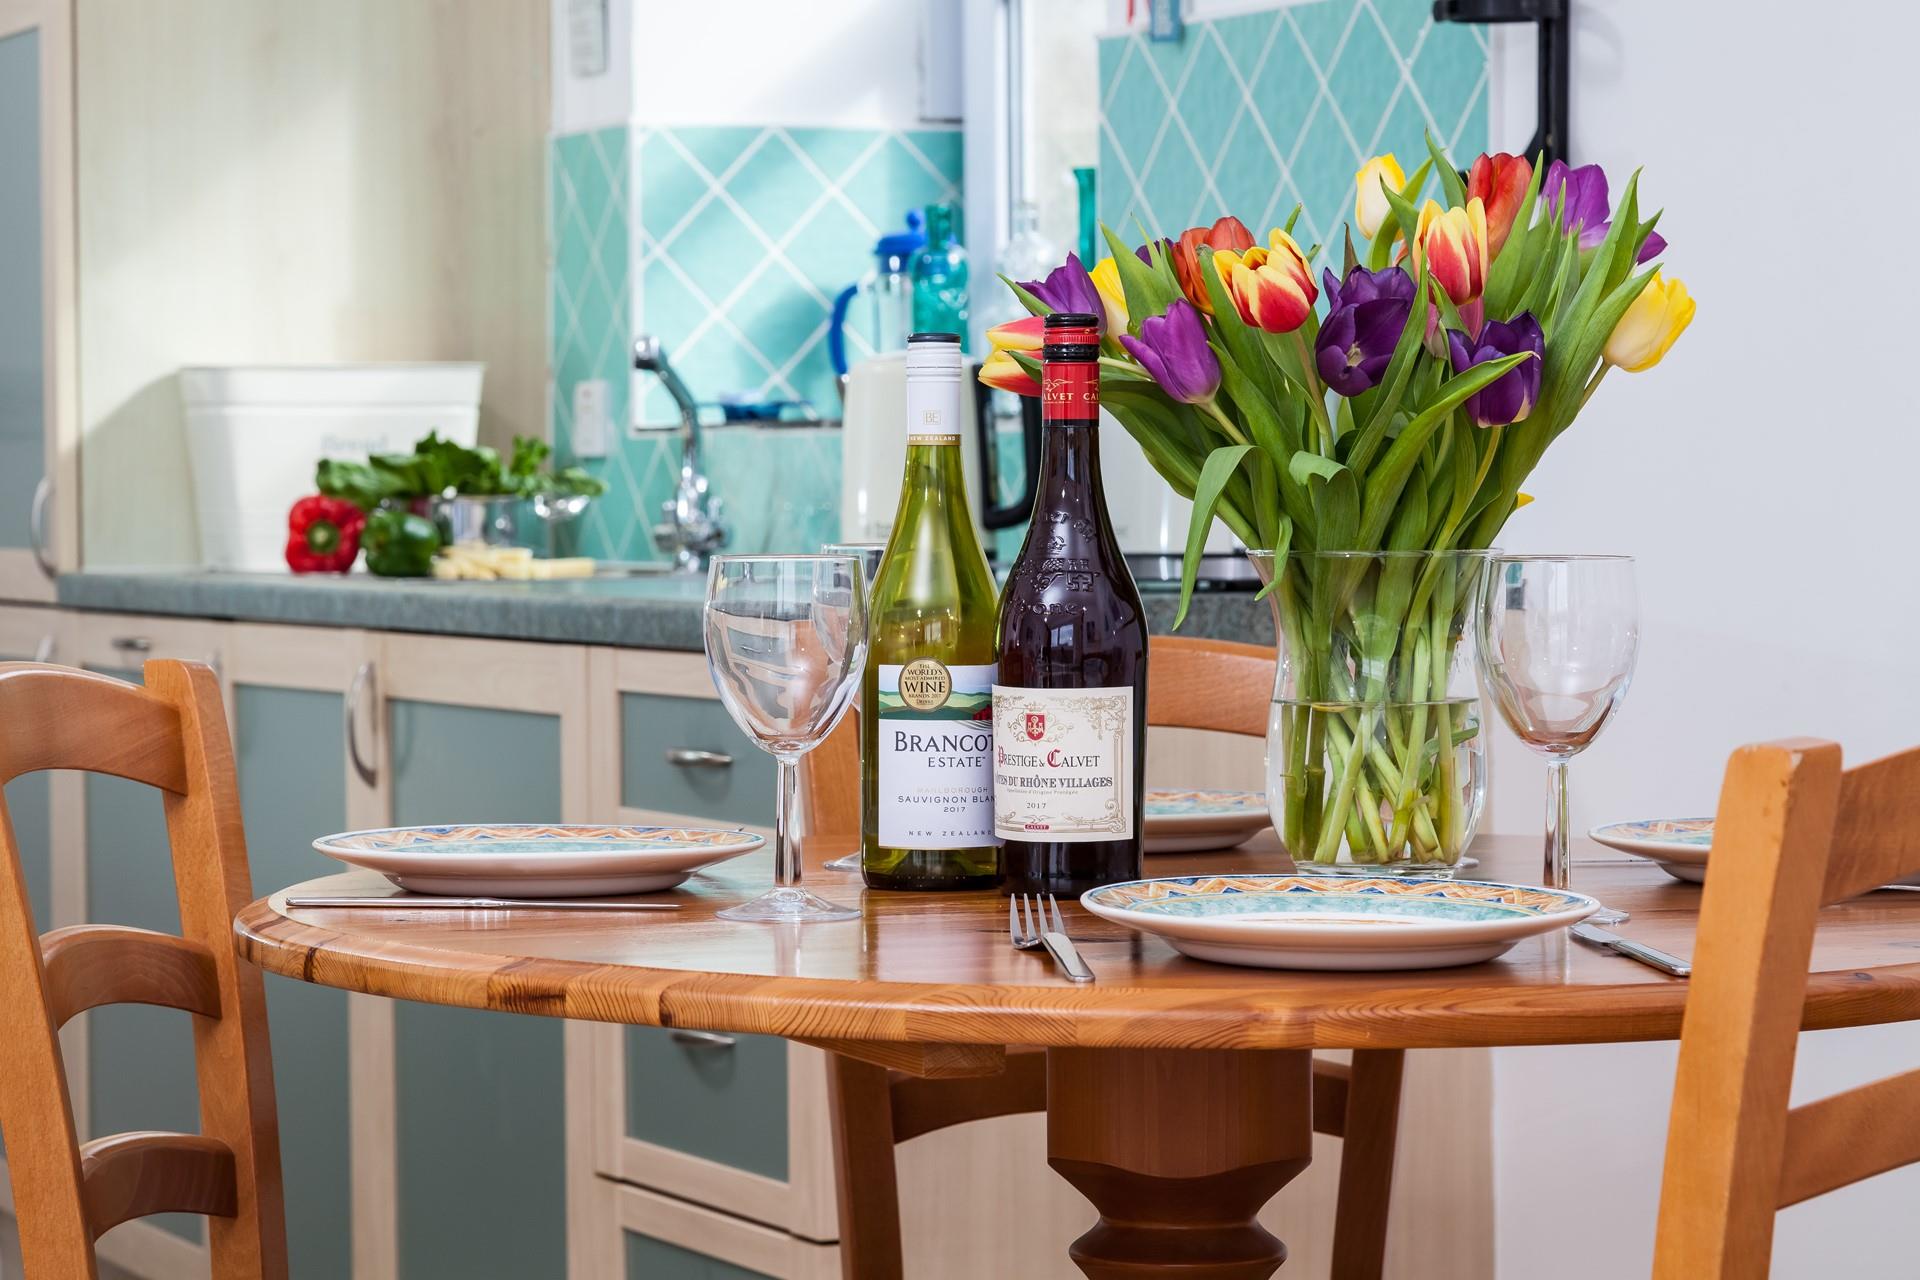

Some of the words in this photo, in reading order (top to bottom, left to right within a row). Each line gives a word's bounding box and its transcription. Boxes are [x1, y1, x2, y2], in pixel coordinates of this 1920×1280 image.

[907, 668, 943, 676] WORLD'S
[904, 681, 946, 693] WINE
[928, 756, 983, 768] ESTATE
[1047, 748, 1100, 768] CALVET
[1008, 776, 1018, 787] DU
[1020, 774, 1057, 788] RHÔNE
[1060, 776, 1113, 788] VILLAGES
[898, 795, 967, 804] SAUVIGNON
